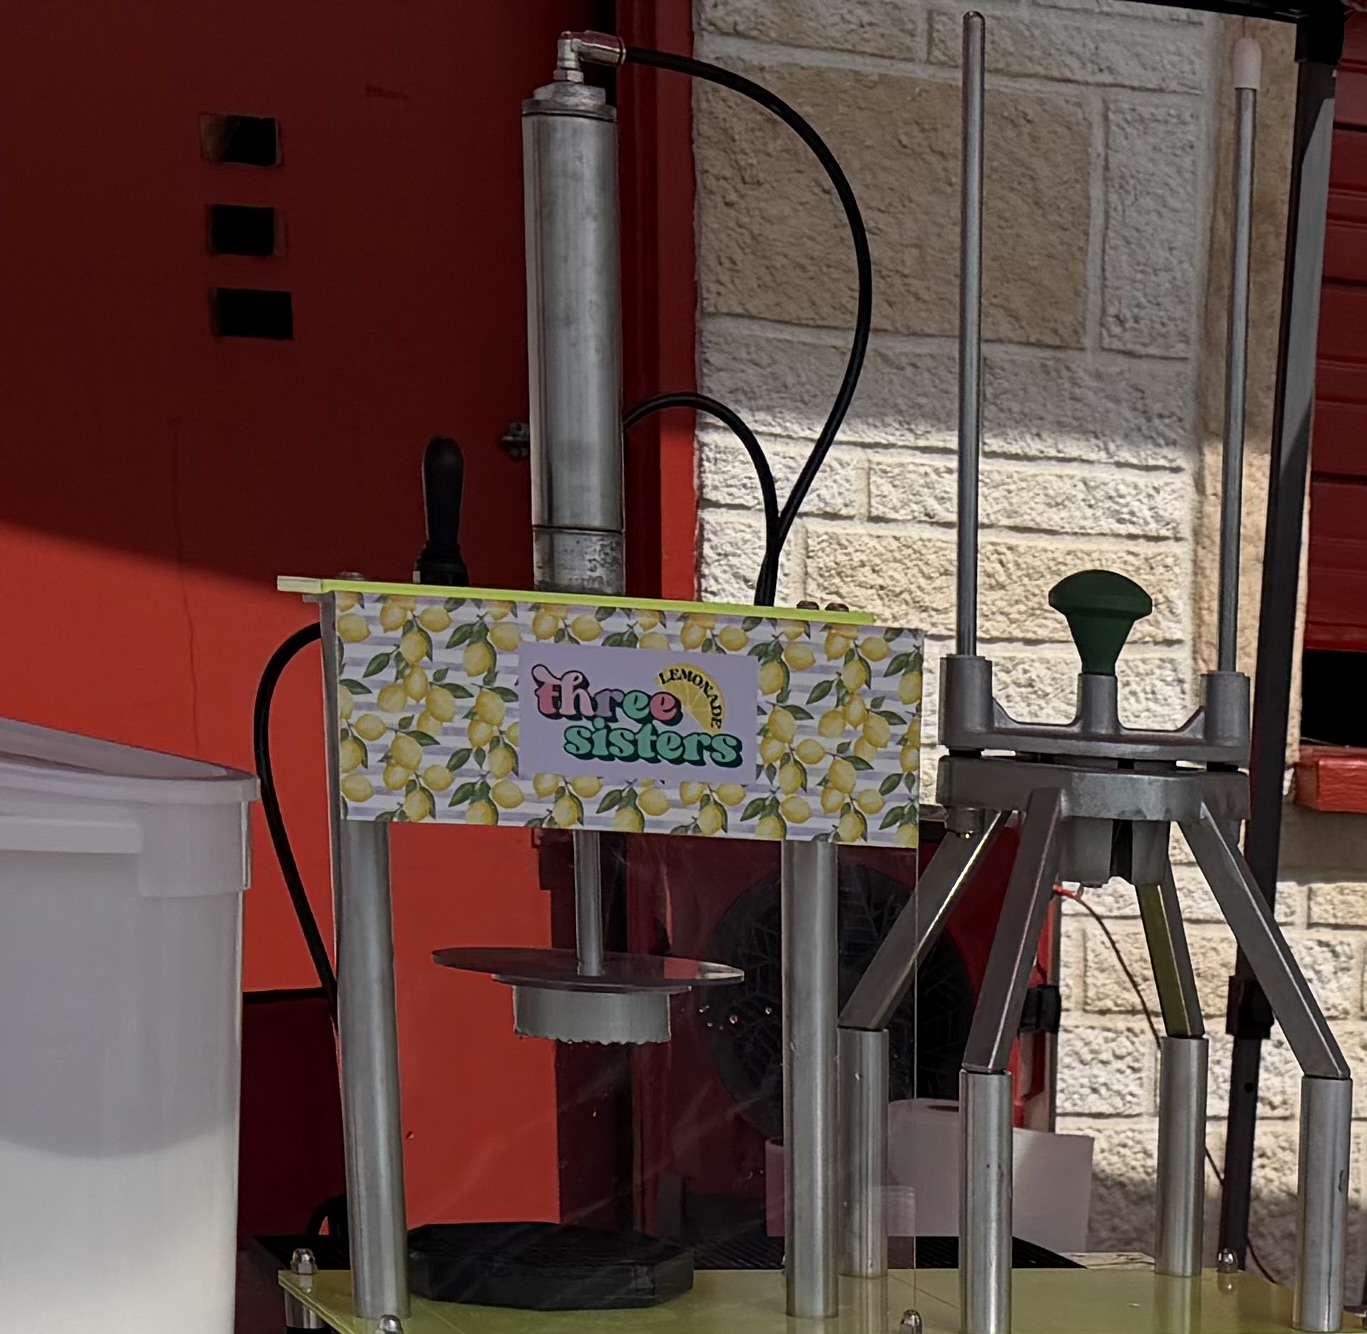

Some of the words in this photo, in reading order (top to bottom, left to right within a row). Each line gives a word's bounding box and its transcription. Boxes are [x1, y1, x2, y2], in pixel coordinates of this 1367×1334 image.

[532, 664, 683, 726] three
[658, 668, 722, 730] LEMONADE
[564, 717, 743, 768] sisters
